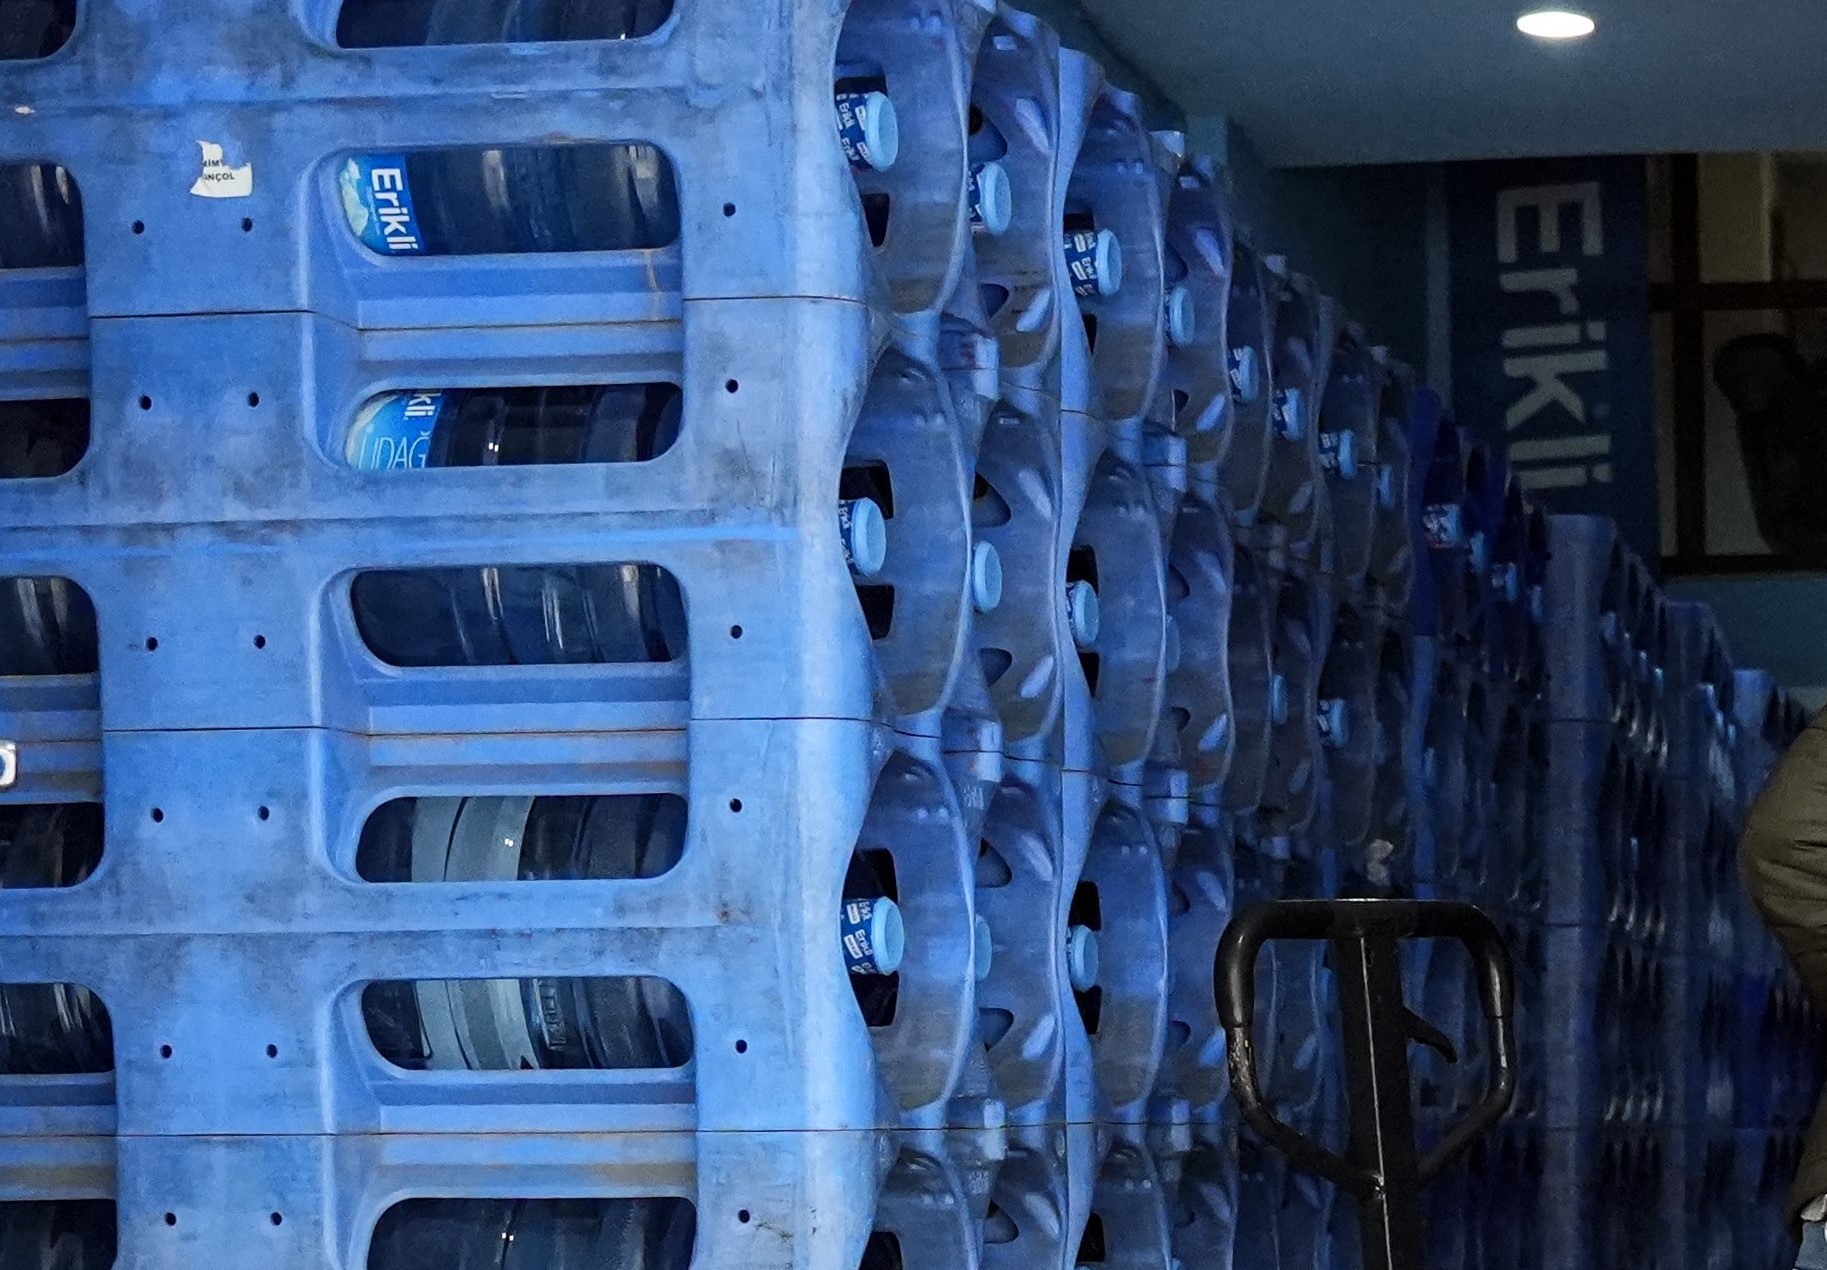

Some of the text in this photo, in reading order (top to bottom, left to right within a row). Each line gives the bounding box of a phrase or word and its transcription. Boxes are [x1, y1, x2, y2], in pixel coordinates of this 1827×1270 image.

[371, 168, 419, 250] Erikli
[1497, 180, 1613, 491] Erikli
[403, 391, 442, 417] kli
